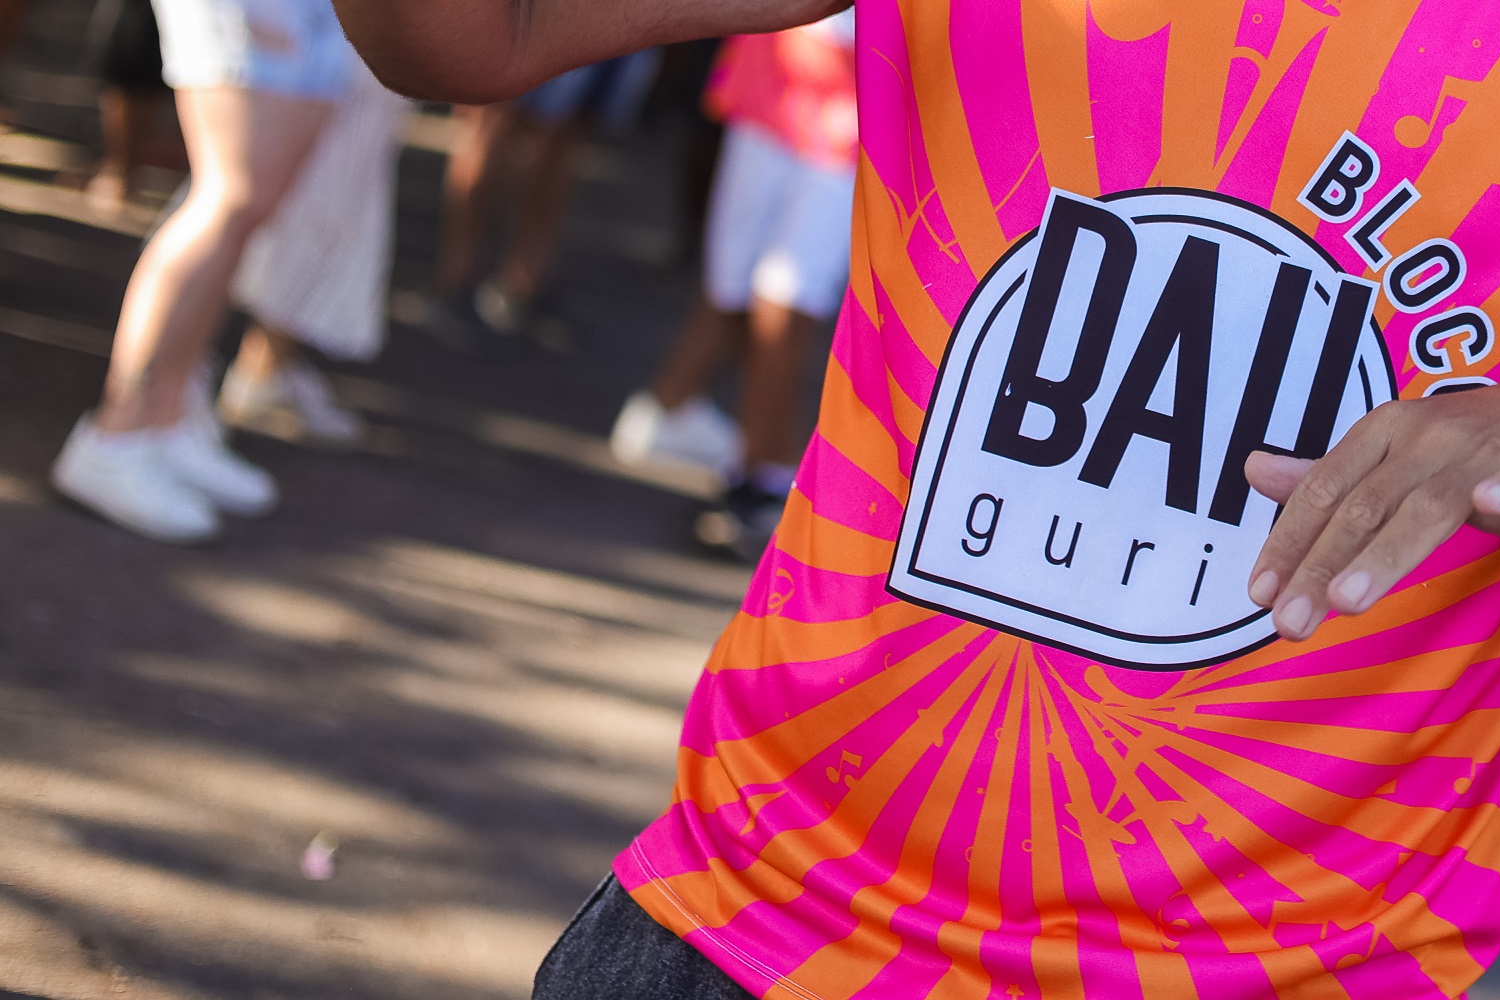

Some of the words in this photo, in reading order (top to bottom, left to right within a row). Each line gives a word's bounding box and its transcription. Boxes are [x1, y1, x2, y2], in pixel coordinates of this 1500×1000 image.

[980, 193, 1373, 531] BAH
[1300, 133, 1496, 397] BLOC
[961, 492, 1214, 606] guri
